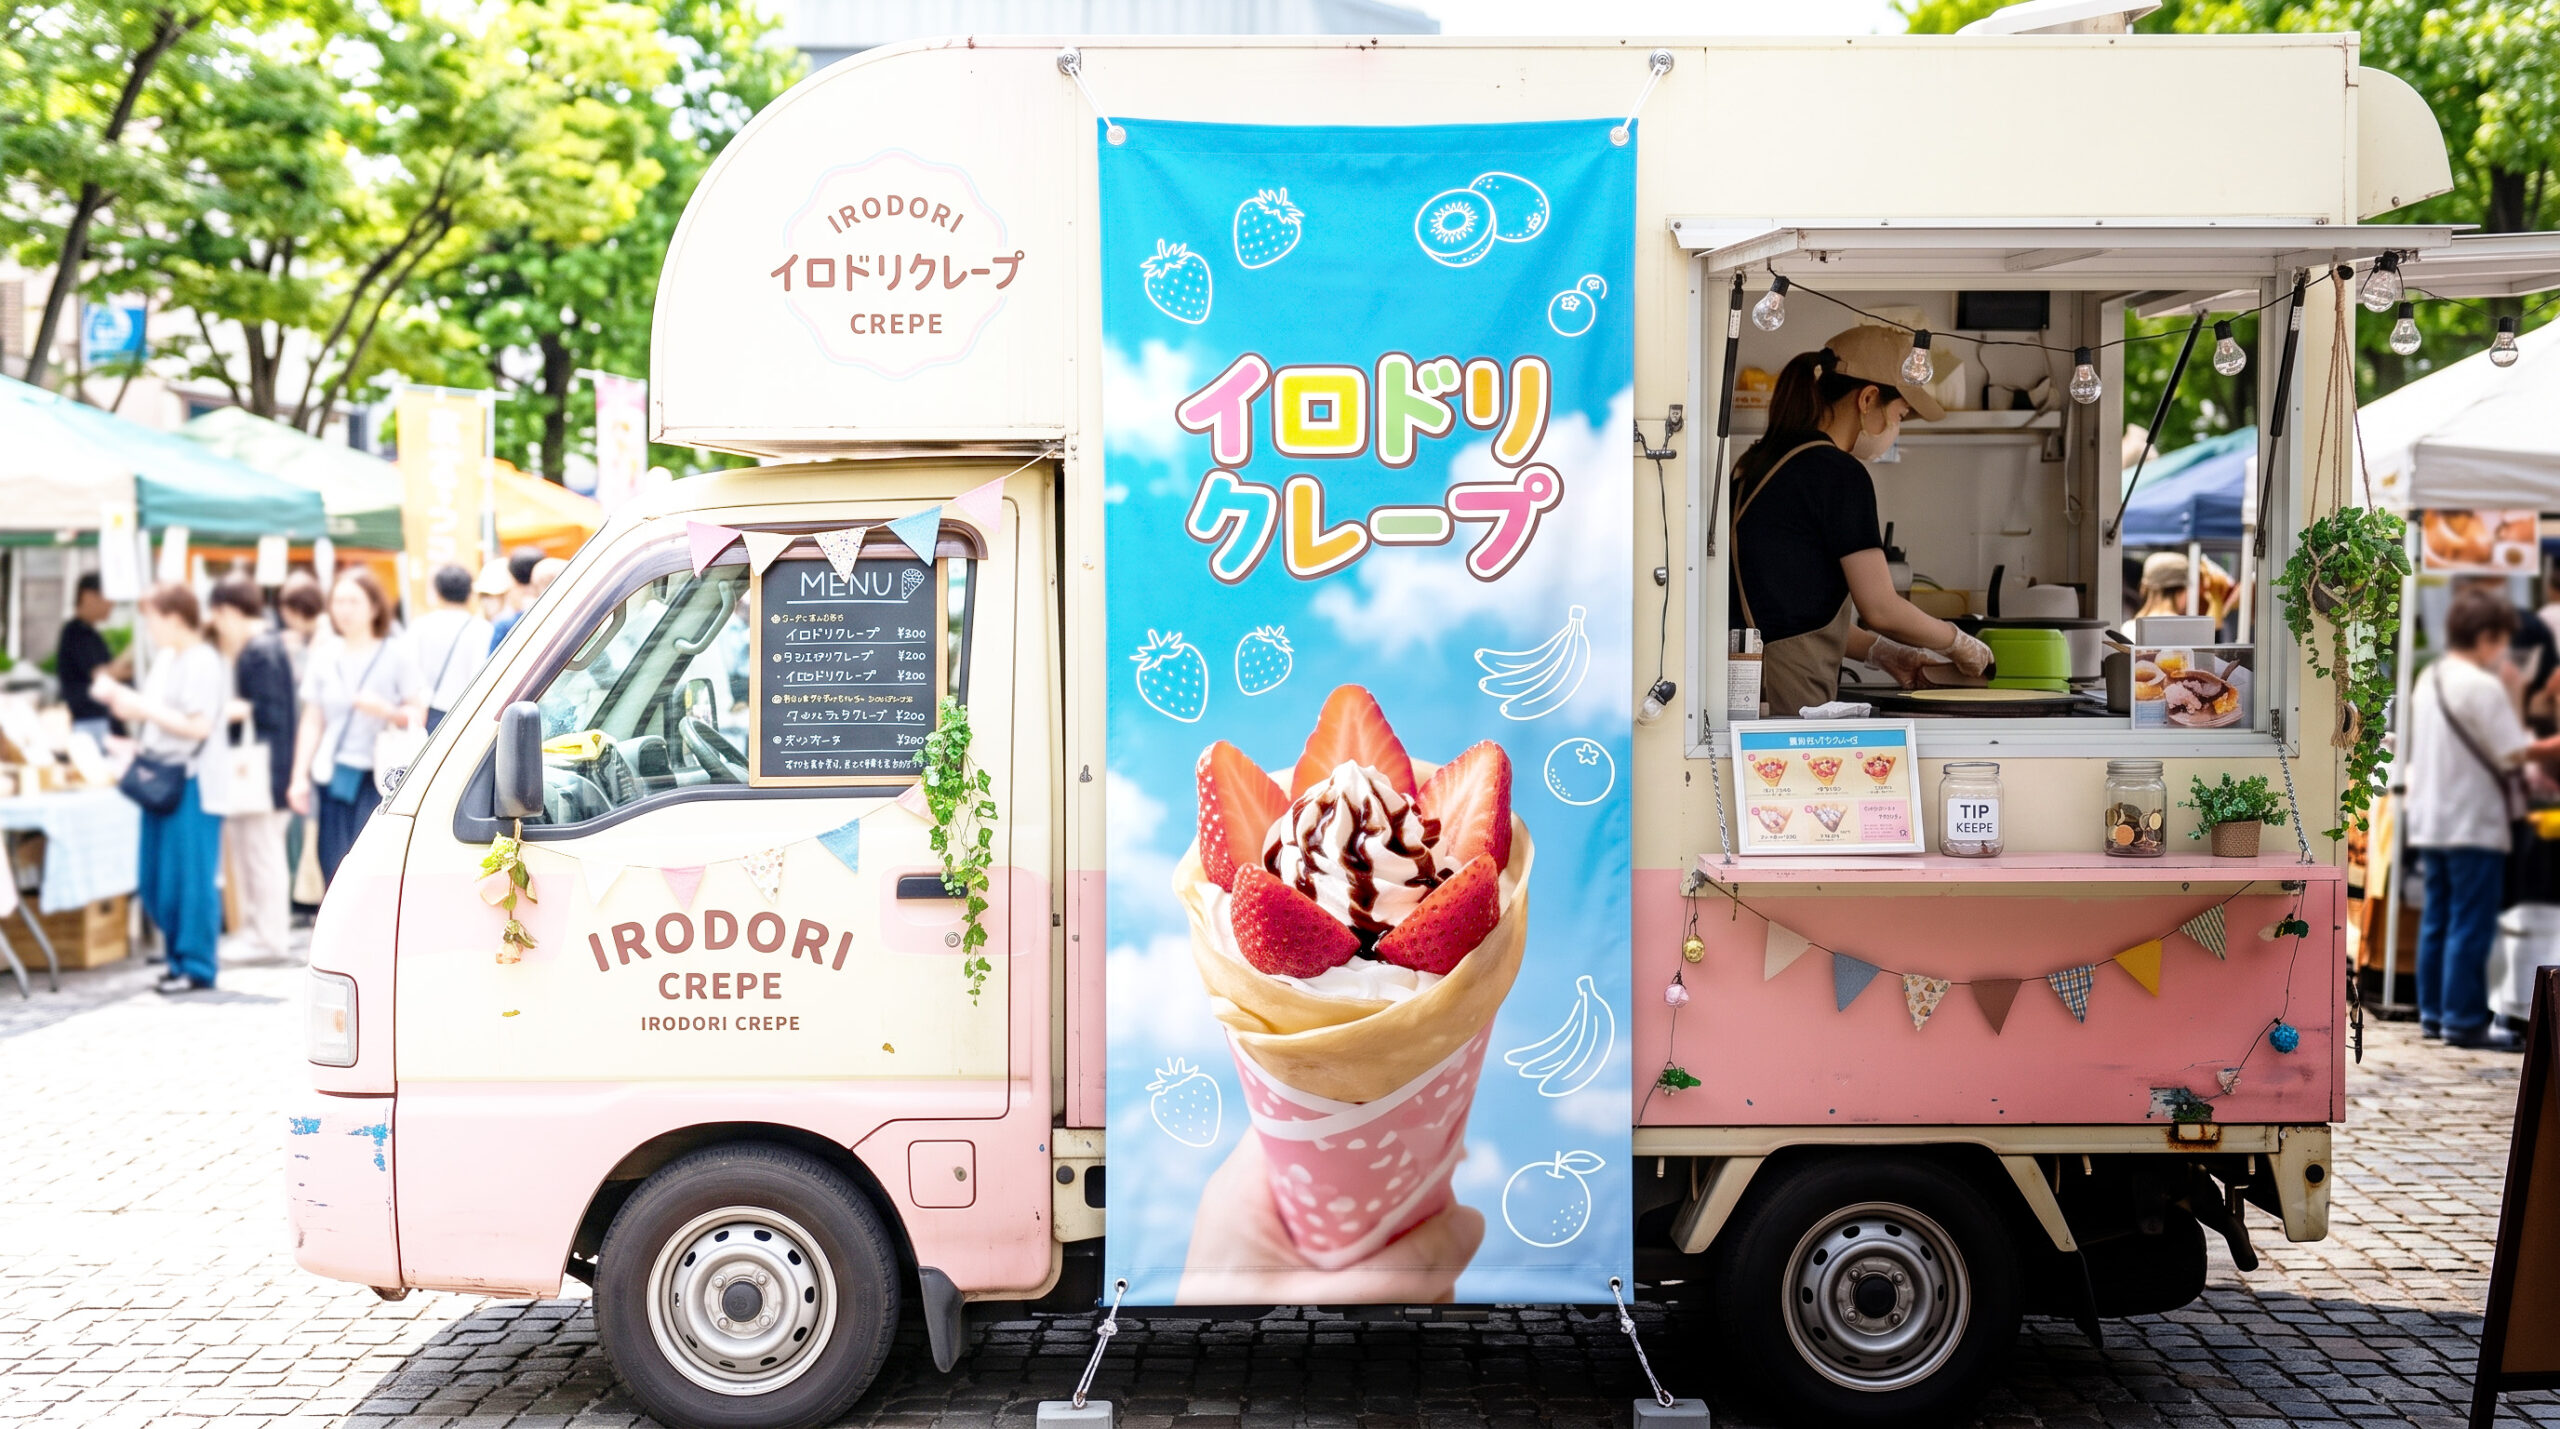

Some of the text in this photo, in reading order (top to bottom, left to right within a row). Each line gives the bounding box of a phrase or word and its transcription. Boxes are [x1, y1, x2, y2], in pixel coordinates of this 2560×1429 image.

[827, 195, 964, 234] IRODORI
[770, 250, 1025, 292] イロドリクレープ
[850, 313, 942, 335] CREPE
[1175, 352, 1551, 469] イロドリ
[1185, 463, 1564, 584] クレープ
[801, 571, 893, 597] MENU
[898, 650, 926, 661] ¥200
[897, 670, 926, 681] ¥200
[896, 709, 926, 722] ¥200
[1960, 804, 1990, 819] TIP
[1956, 822, 1993, 833] KEEPE
[588, 909, 854, 972] IRODORI
[658, 972, 782, 1000] CREPE
[641, 1016, 800, 1031] IRODORI CREPE
